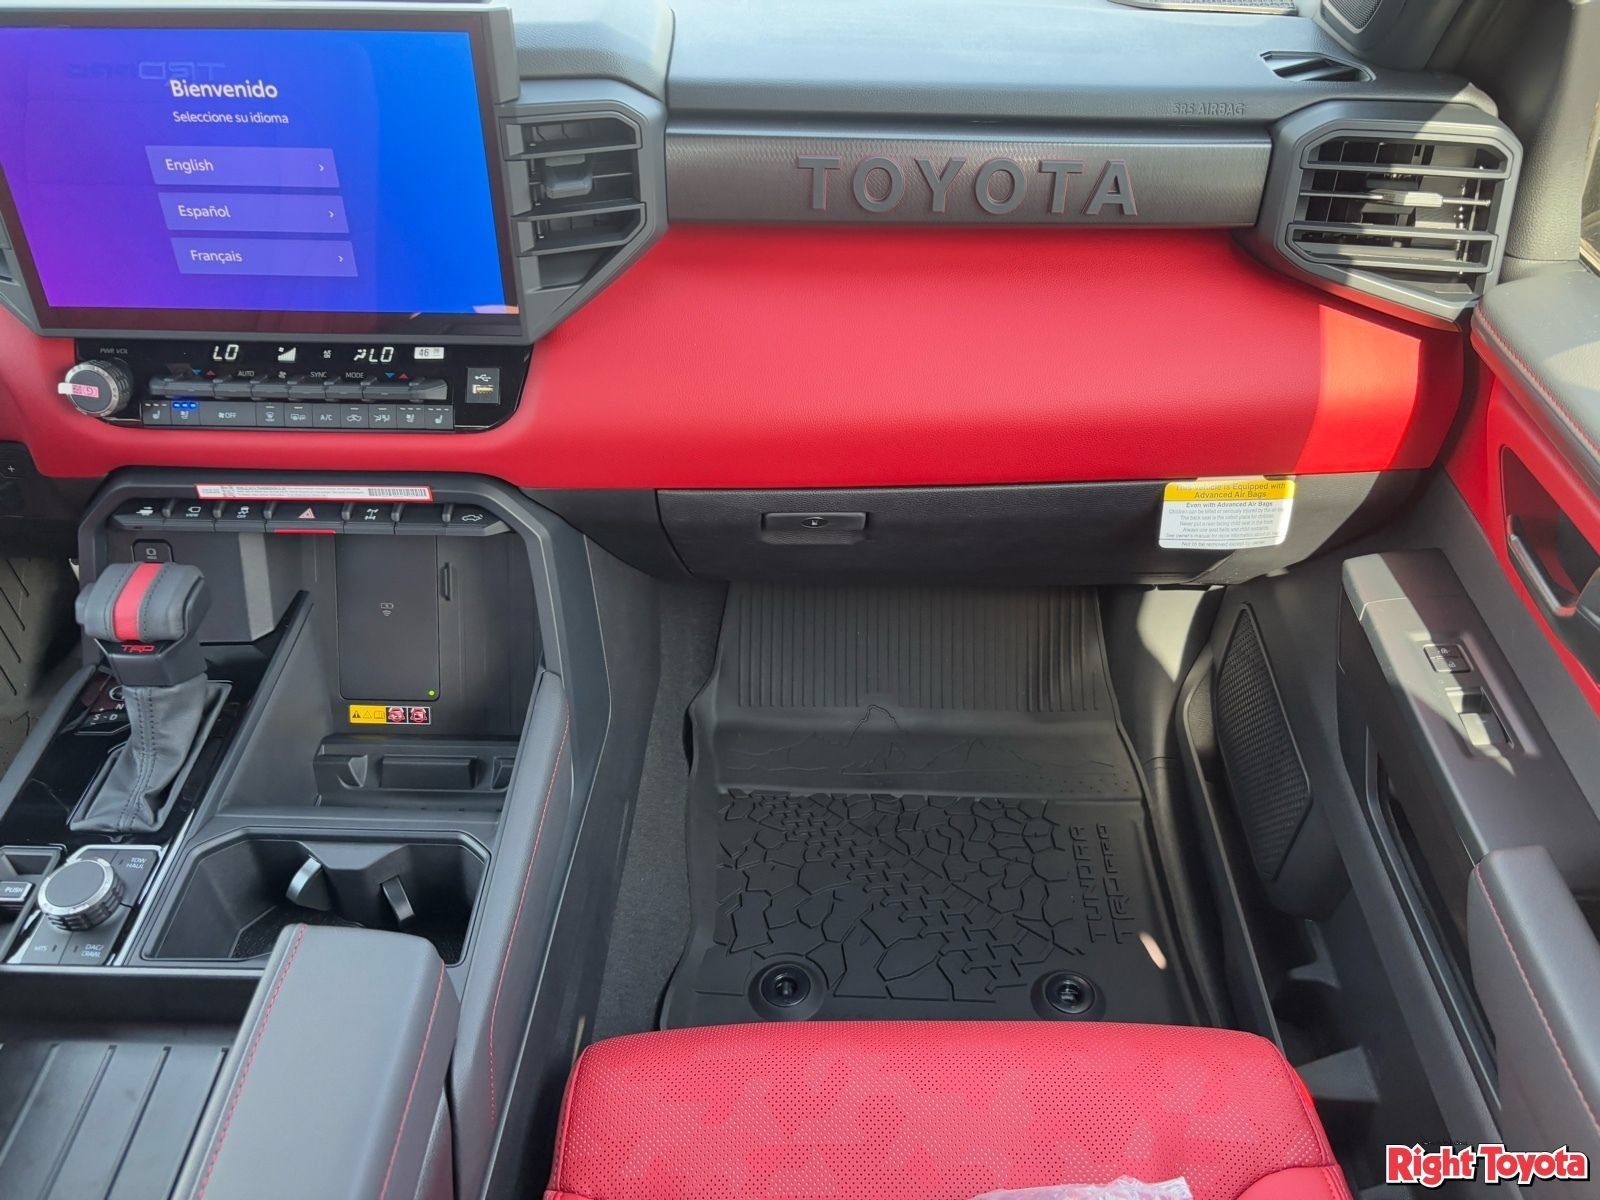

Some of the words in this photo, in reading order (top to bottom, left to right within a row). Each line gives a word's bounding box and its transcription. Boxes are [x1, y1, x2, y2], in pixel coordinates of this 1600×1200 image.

[169, 79, 278, 98] Bienvenido
[1173, 102, 1195, 114] SRS
[1198, 102, 1245, 116] AIRBAG
[172, 111, 233, 123] Seleccione
[235, 113, 248, 123] su
[249, 112, 289, 124] idioma
[164, 158, 214, 174] English
[798, 154, 1138, 216] TOYOTA
[178, 205, 231, 220] Español
[190, 249, 243, 264] Français
[100, 347, 115, 355] PWR
[212, 344, 240, 360] LO
[368, 346, 395, 362] LO
[238, 369, 255, 377] AUTO
[1233, 482, 1268, 491] Equipped
[1194, 490, 1232, 499] Advanced
[1234, 490, 1245, 498] Air
[1248, 490, 1267, 498] Bags
[1217, 500, 1246, 508] Advanced
[1258, 500, 1273, 508] Bags
[1068, 824, 1107, 943] TUNDRA
